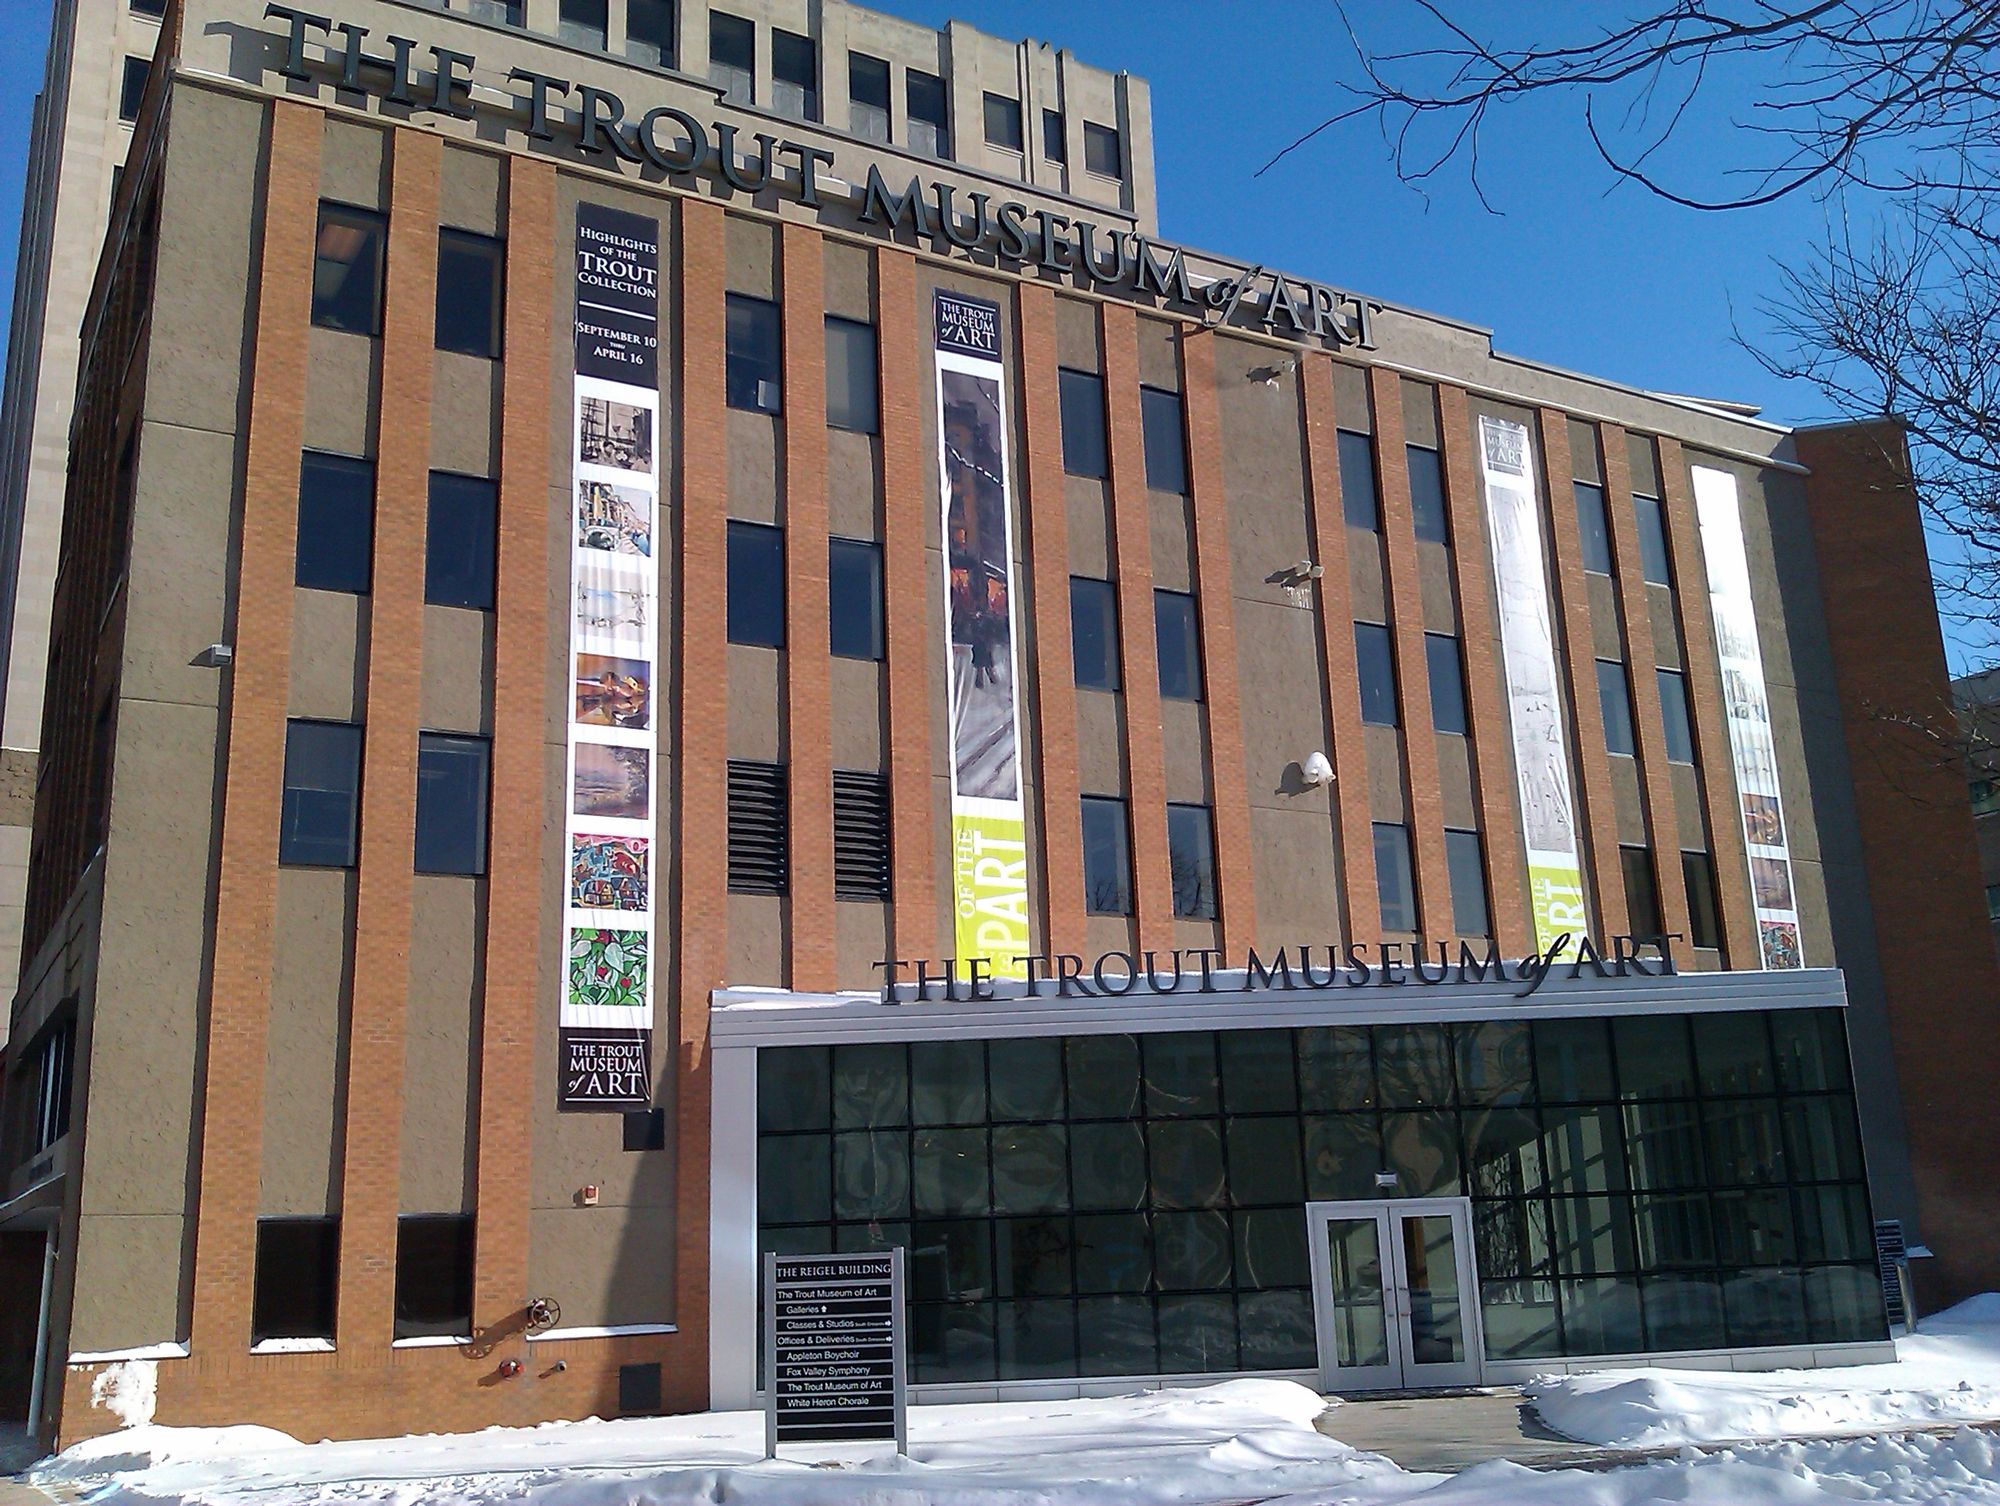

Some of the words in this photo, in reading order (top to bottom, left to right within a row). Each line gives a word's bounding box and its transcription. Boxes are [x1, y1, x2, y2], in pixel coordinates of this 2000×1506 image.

[263, 2, 476, 121] THE
[507, 66, 834, 208] TROUT
[858, 163, 1198, 304] MUSEUM
[1200, 264, 1263, 327] of
[1260, 271, 1383, 350] ART
[580, 226, 657, 254] HIGHLIGHTS
[600, 246, 614, 256] OF
[616, 249, 637, 261] THE
[579, 251, 657, 285] TROUT
[578, 272, 656, 299] COLLECTION
[941, 302, 960, 314] THE
[962, 307, 994, 322] TROUT
[941, 311, 995, 333] MUSEUM
[578, 321, 641, 345] SEPTEMBER
[644, 336, 657, 348] 10
[941, 325, 954, 338] of
[954, 325, 995, 349] ART
[593, 346, 627, 362] APRIL
[630, 353, 643, 365] 16
[956, 828, 974, 877] THE
[957, 879, 976, 919] OF
[872, 956, 994, 1005] THE
[1012, 949, 1222, 998] TROUT
[1243, 934, 1511, 991] MUSEUM
[1513, 932, 1570, 998] of
[1567, 933, 1684, 980] ART
[570, 1045, 596, 1057] THE
[599, 1045, 642, 1057] TROUT
[569, 1057, 642, 1072] MUSEUM
[568, 1074, 586, 1094] of
[585, 1072, 642, 1095] ART
[777, 1267, 798, 1277] THE
[800, 1266, 837, 1277] REIGEL
[839, 1264, 891, 1275] BUILDING
[777, 1290, 793, 1299] The
[794, 1290, 815, 1298] Trout
[817, 1289, 852, 1298] Museum
[854, 1288, 863, 1296] of
[864, 1288, 877, 1296] Art
[786, 1305, 819, 1314] Galleries
[786, 1321, 817, 1330] Classes
[818, 1320, 825, 1329] &
[826, 1319, 854, 1328] Studios
[777, 1336, 805, 1345] Offices
[807, 1336, 813, 1344] &
[815, 1335, 855, 1344] Deliveries
[786, 1352, 822, 1361] Appleton
[824, 1350, 860, 1360] Boychoir
[786, 1367, 801, 1376] Fox
[803, 1367, 827, 1377] Valley
[828, 1366, 871, 1376] Symphony
[787, 1383, 802, 1392] The
[804, 1382, 824, 1391] Trout
[825, 1381, 859, 1390] Museum
[860, 1381, 868, 1389] of
[870, 1380, 882, 1389] Art
[787, 1398, 810, 1407] White
[812, 1398, 836, 1406] Heron
[838, 1396, 869, 1406] Chorale
